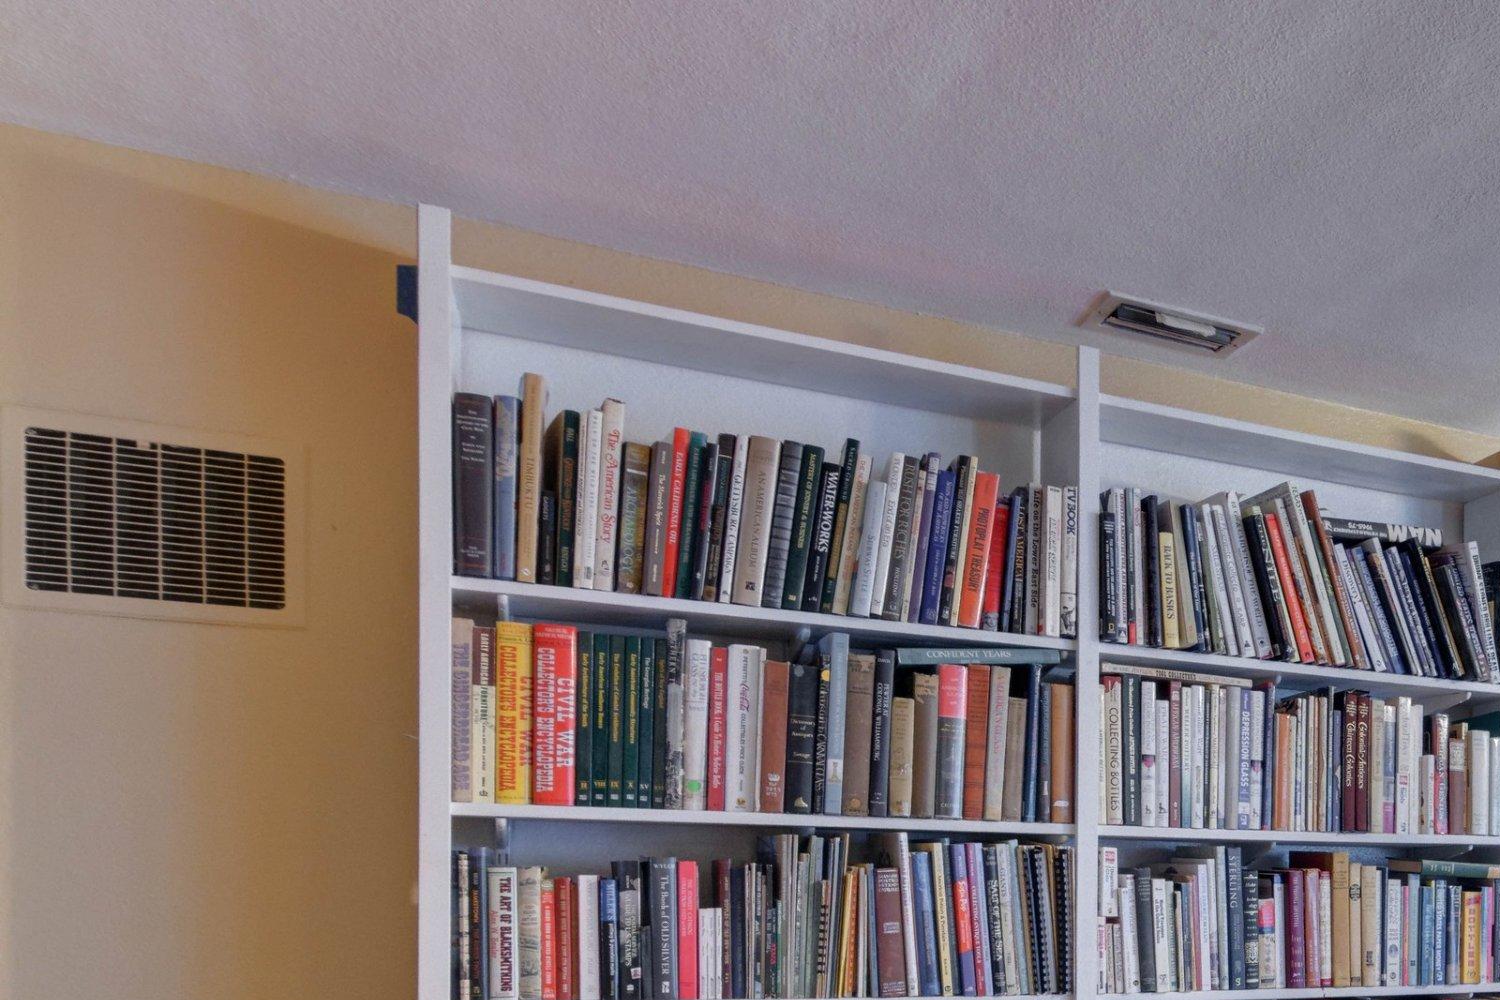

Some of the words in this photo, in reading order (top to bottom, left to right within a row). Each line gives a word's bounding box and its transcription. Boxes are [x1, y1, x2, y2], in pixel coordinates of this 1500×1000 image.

[607, 429, 620, 451] The
[674, 452, 684, 478] EARLY
[846, 447, 856, 469] SACRED
[525, 456, 535, 509] TIMBUKTU
[603, 453, 619, 510] American
[757, 470, 767, 485] AN
[841, 472, 852, 500] GROUND
[902, 464, 915, 493] RUSH
[670, 480, 681, 529] CALIFORNIA
[728, 474, 742, 531] GETTYSBURG
[752, 486, 765, 534] AMERICAN
[817, 471, 838, 552] WATER-WORKS
[899, 496, 912, 517] FOR
[954, 500, 962, 524] SHAKER
[1017, 505, 1025, 531] LOST
[601, 515, 616, 544] Story
[622, 486, 637, 573] ARCHAEOLOGY
[669, 531, 677, 544] OIL
[895, 519, 910, 560] RICHES
[950, 525, 959, 559] FURNITURE
[972, 507, 990, 551] PHOTOPLAY
[1387, 524, 1442, 547] NAM
[724, 534, 737, 574] CAMPAIGN
[748, 536, 760, 568] ALBUM
[1015, 535, 1024, 579] AMERICA
[1031, 539, 1039, 566] Lower
[1163, 545, 1174, 569] BACK
[968, 553, 985, 592] TREASURY
[1165, 571, 1174, 584] TO
[1165, 587, 1175, 620] BASICS
[453, 643, 470, 668] THE
[480, 633, 489, 652] EARLY
[926, 649, 976, 658] CONFIDENT
[480, 653, 488, 685] AMERICAN
[500, 645, 516, 711] COLLECTOR'S
[537, 647, 554, 712] COLLECTOR'S
[480, 687, 488, 721] FURNITURE
[556, 678, 574, 722] CIVIL
[875, 682, 884, 714] COLONIAL
[453, 670, 470, 762] GINGERBREAD
[556, 730, 574, 767] WAR
[874, 716, 882, 761] WILLIAMSBURG
[1109, 707, 1119, 768] COLLECTING
[1241, 711, 1250, 760] DEPRESSION
[1346, 721, 1356, 754] Thirteen
[1358, 722, 1367, 754] Colonial
[499, 716, 516, 791] ENCYCLOPEDIA
[536, 717, 554, 792] ENCYCLOPEDIA
[453, 765, 470, 790] AGE
[1240, 762, 1249, 787] GLASS
[1345, 754, 1355, 787] Colonies
[1357, 753, 1367, 789] Antiques
[1110, 772, 1119, 811] BOTTLES
[499, 877, 512, 894] THE
[660, 876, 669, 889] The
[990, 880, 999, 905] SALT
[1228, 855, 1237, 908] STERLING
[500, 895, 512, 912] ART
[605, 883, 616, 921] MILLER'S
[660, 891, 669, 909] Book
[992, 906, 1000, 919] OF
[500, 914, 512, 924] OF
[661, 921, 669, 942] OLD
[994, 921, 1002, 938] THE
[499, 927, 512, 992] BLACKSMITHING
[661, 942, 669, 975] SILVER
[995, 940, 1003, 961] SEA
